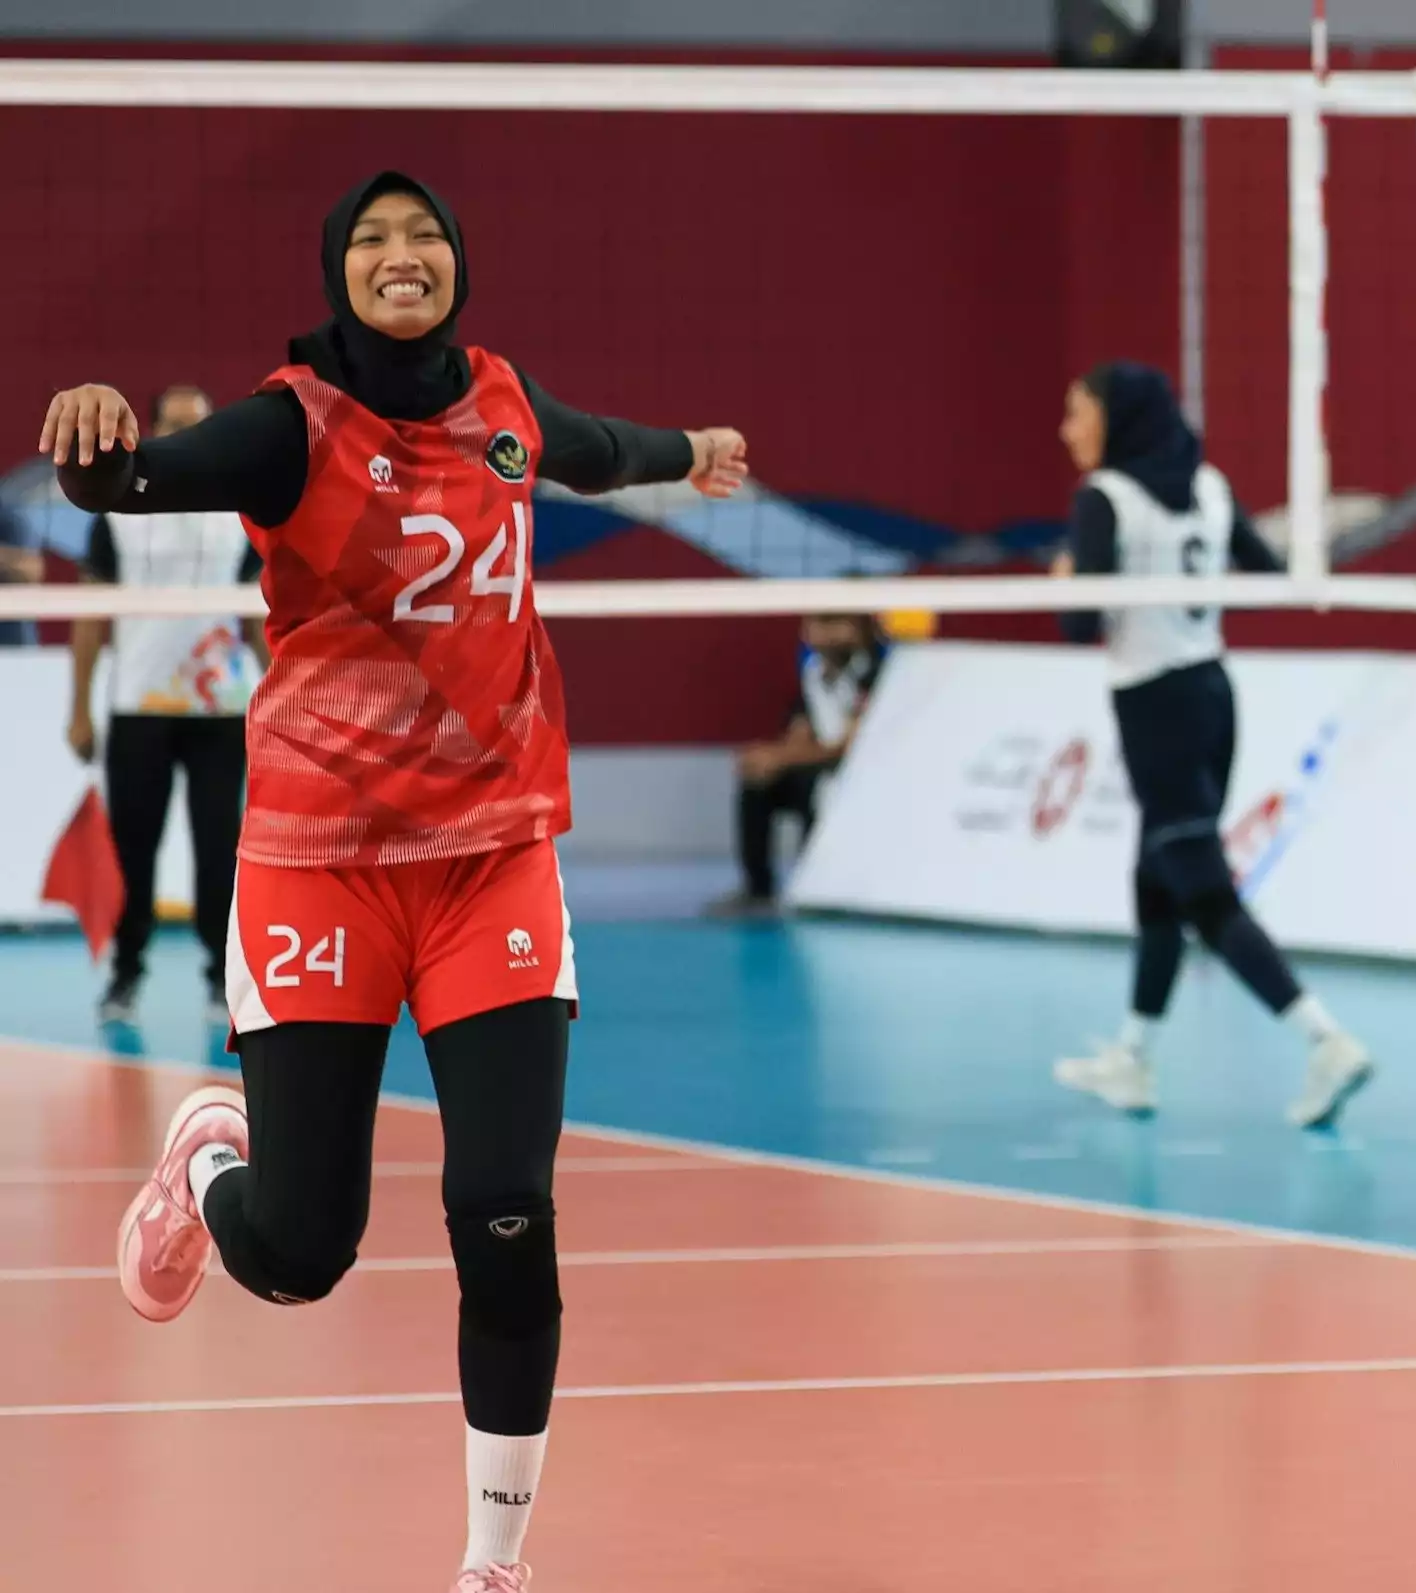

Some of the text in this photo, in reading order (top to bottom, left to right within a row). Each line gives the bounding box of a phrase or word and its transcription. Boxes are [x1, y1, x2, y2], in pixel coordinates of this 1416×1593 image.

[392, 501, 527, 624] 24
[265, 924, 345, 988] 24
[508, 956, 540, 970] MILLS
[482, 1488, 533, 1506] MILLS
